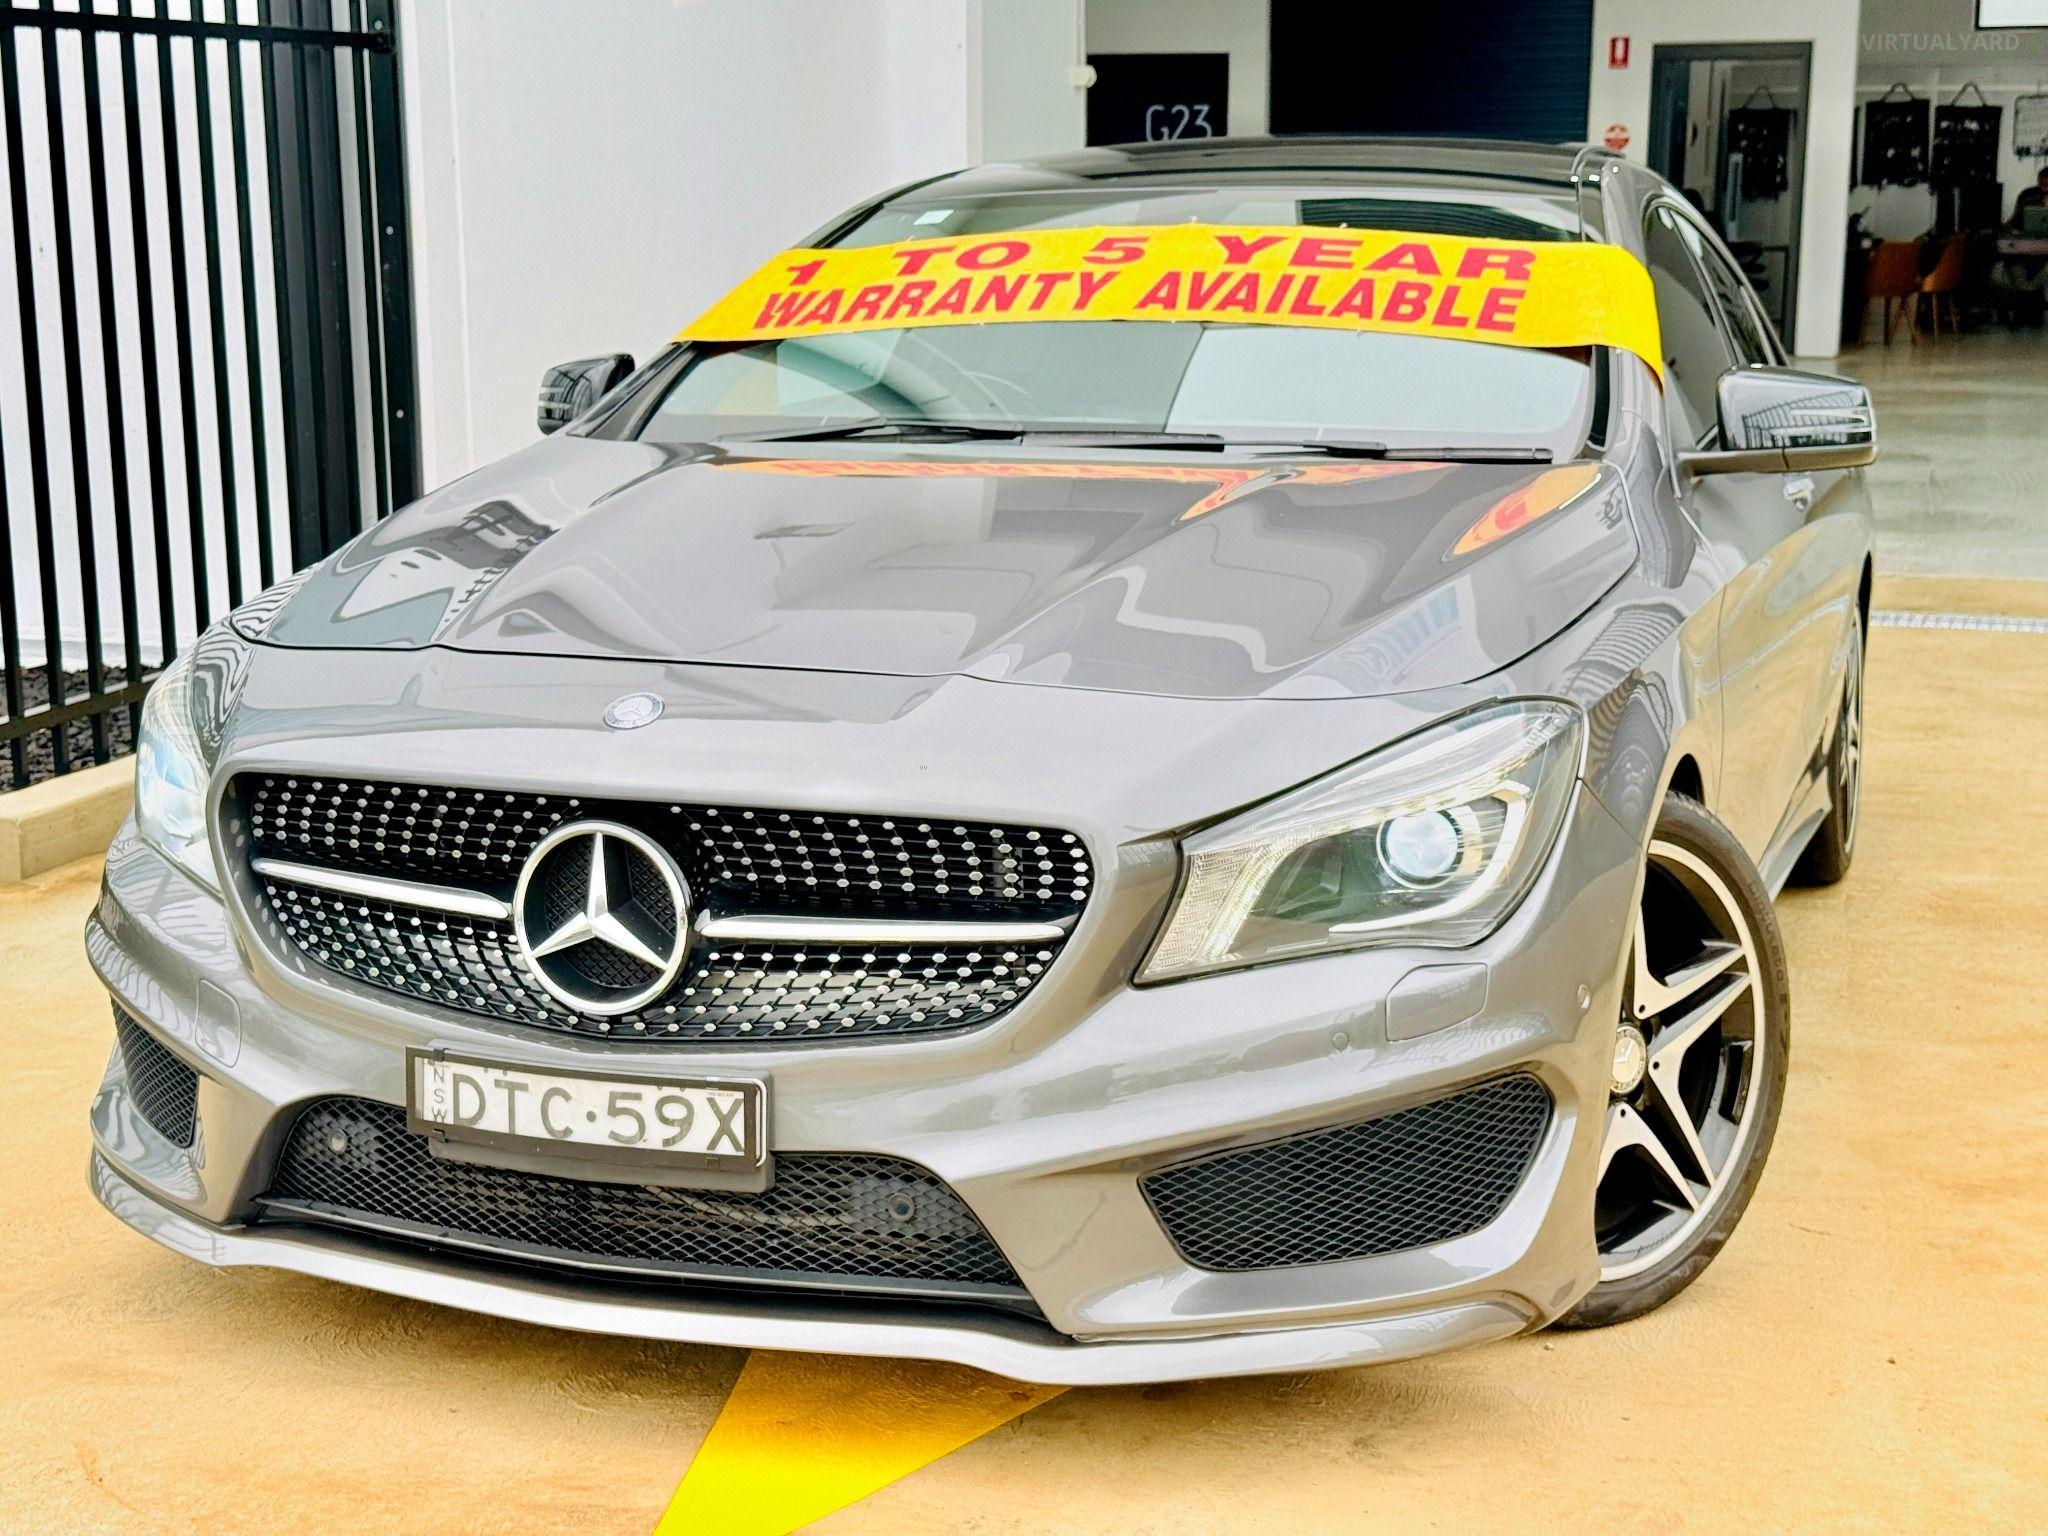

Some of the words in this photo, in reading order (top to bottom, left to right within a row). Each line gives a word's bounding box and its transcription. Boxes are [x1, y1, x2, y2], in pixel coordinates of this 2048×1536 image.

[1145, 104, 1212, 141] G23
[787, 259, 826, 286] 1
[893, 240, 1031, 276] TO
[1083, 236, 1152, 264] 5
[1214, 236, 1537, 281] YEAR
[753, 271, 1118, 329] WARRANTY
[1134, 271, 1526, 333] AVAILABLE
[431, 1067, 448, 1123] NSW
